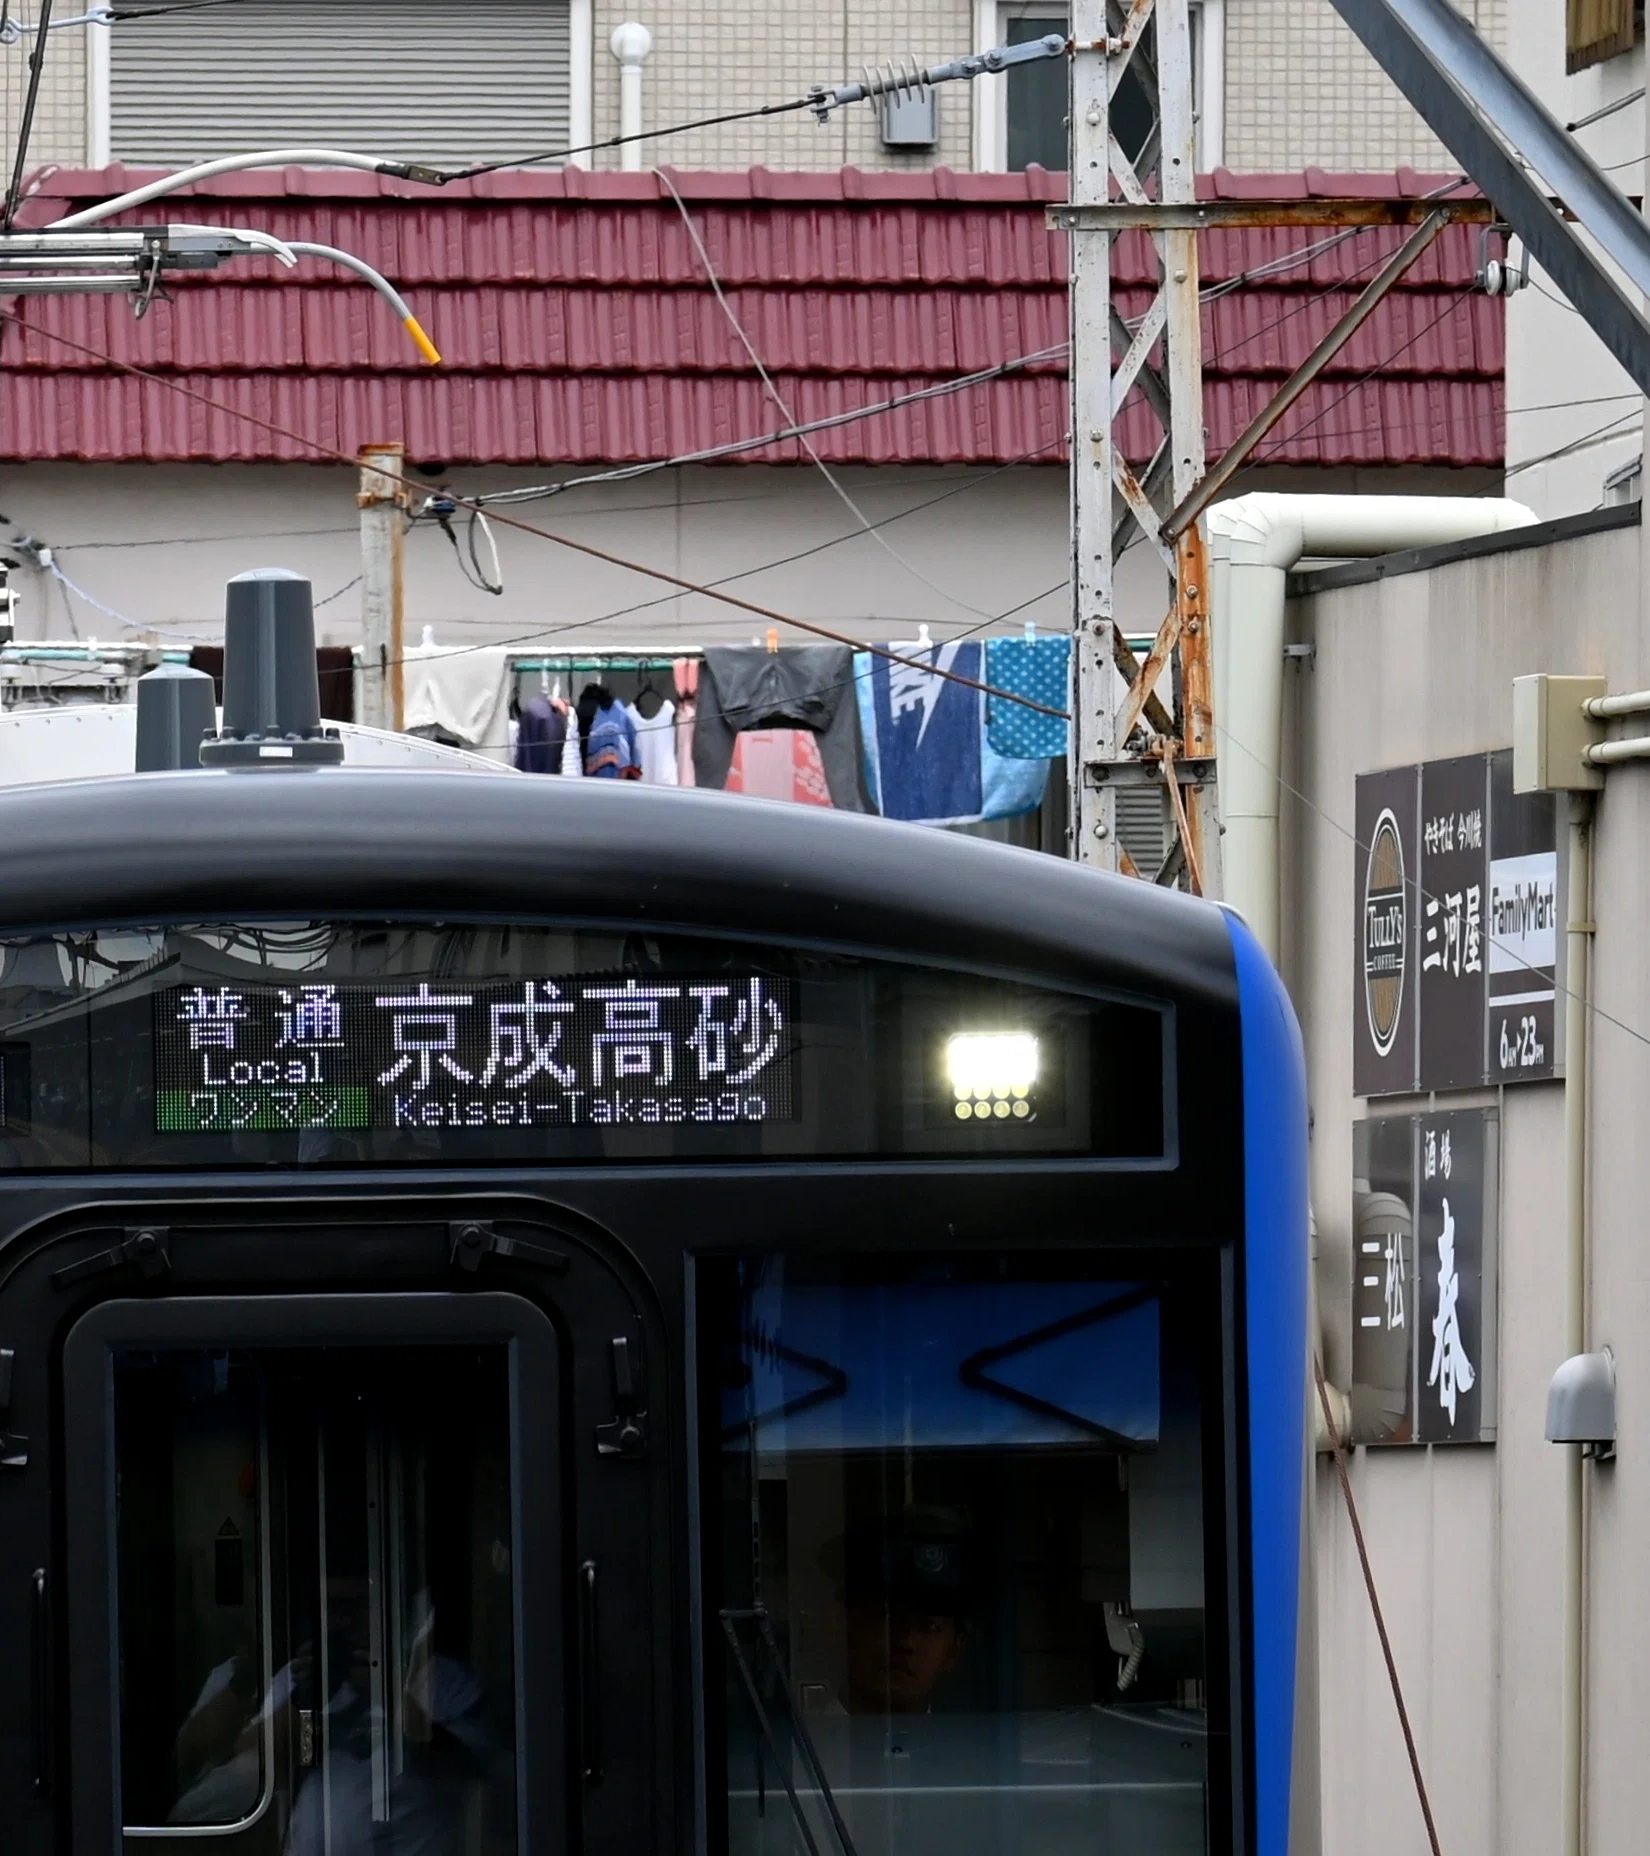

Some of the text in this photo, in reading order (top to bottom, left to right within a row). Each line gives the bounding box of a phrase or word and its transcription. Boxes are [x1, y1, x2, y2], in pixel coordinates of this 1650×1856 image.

[1424, 808, 1482, 855] やきそば 今川焼
[1422, 884, 1482, 978] 三河屋
[1492, 882, 1554, 941] FamilyMart
[1373, 953, 1396, 971] COFFEE
[176, 984, 345, 1050] 普通
[375, 976, 783, 1089] 京成高砂
[203, 1052, 325, 1085] Local
[190, 1091, 339, 1127] ワンマン
[394, 1091, 767, 1127] Keisei-Takasago
[1425, 1129, 1451, 1180] 酒場
[1361, 1232, 1405, 1331] 三松
